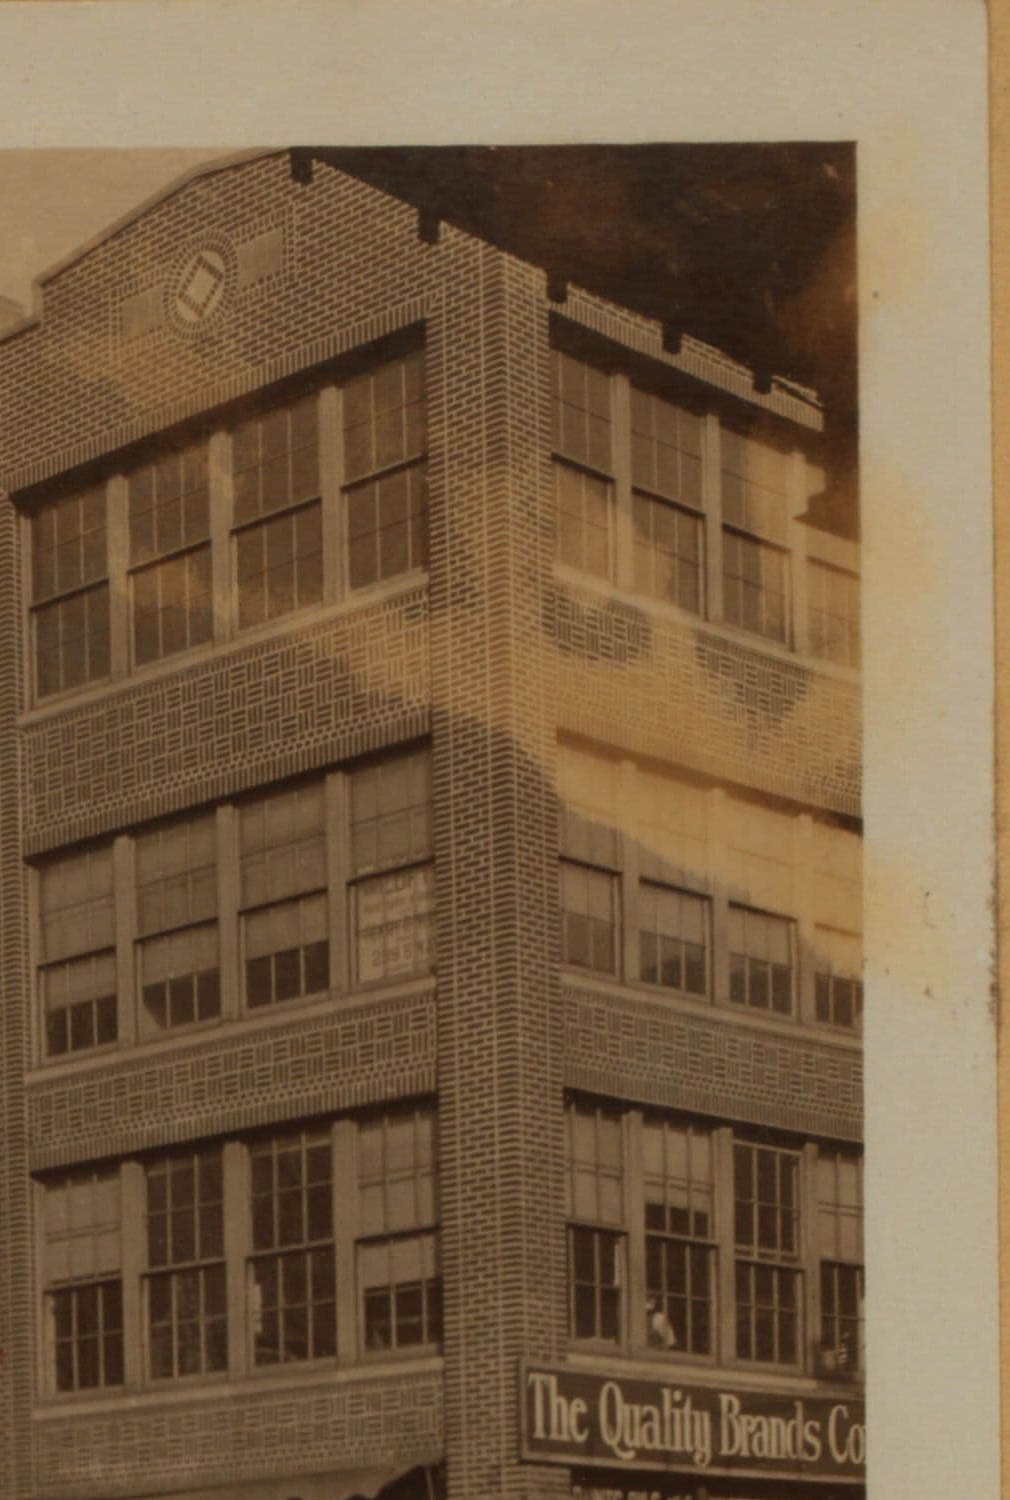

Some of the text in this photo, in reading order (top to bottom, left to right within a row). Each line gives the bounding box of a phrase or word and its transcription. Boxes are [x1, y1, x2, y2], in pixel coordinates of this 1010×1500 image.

[528, 1372, 867, 1466] The Quality Brands Co
